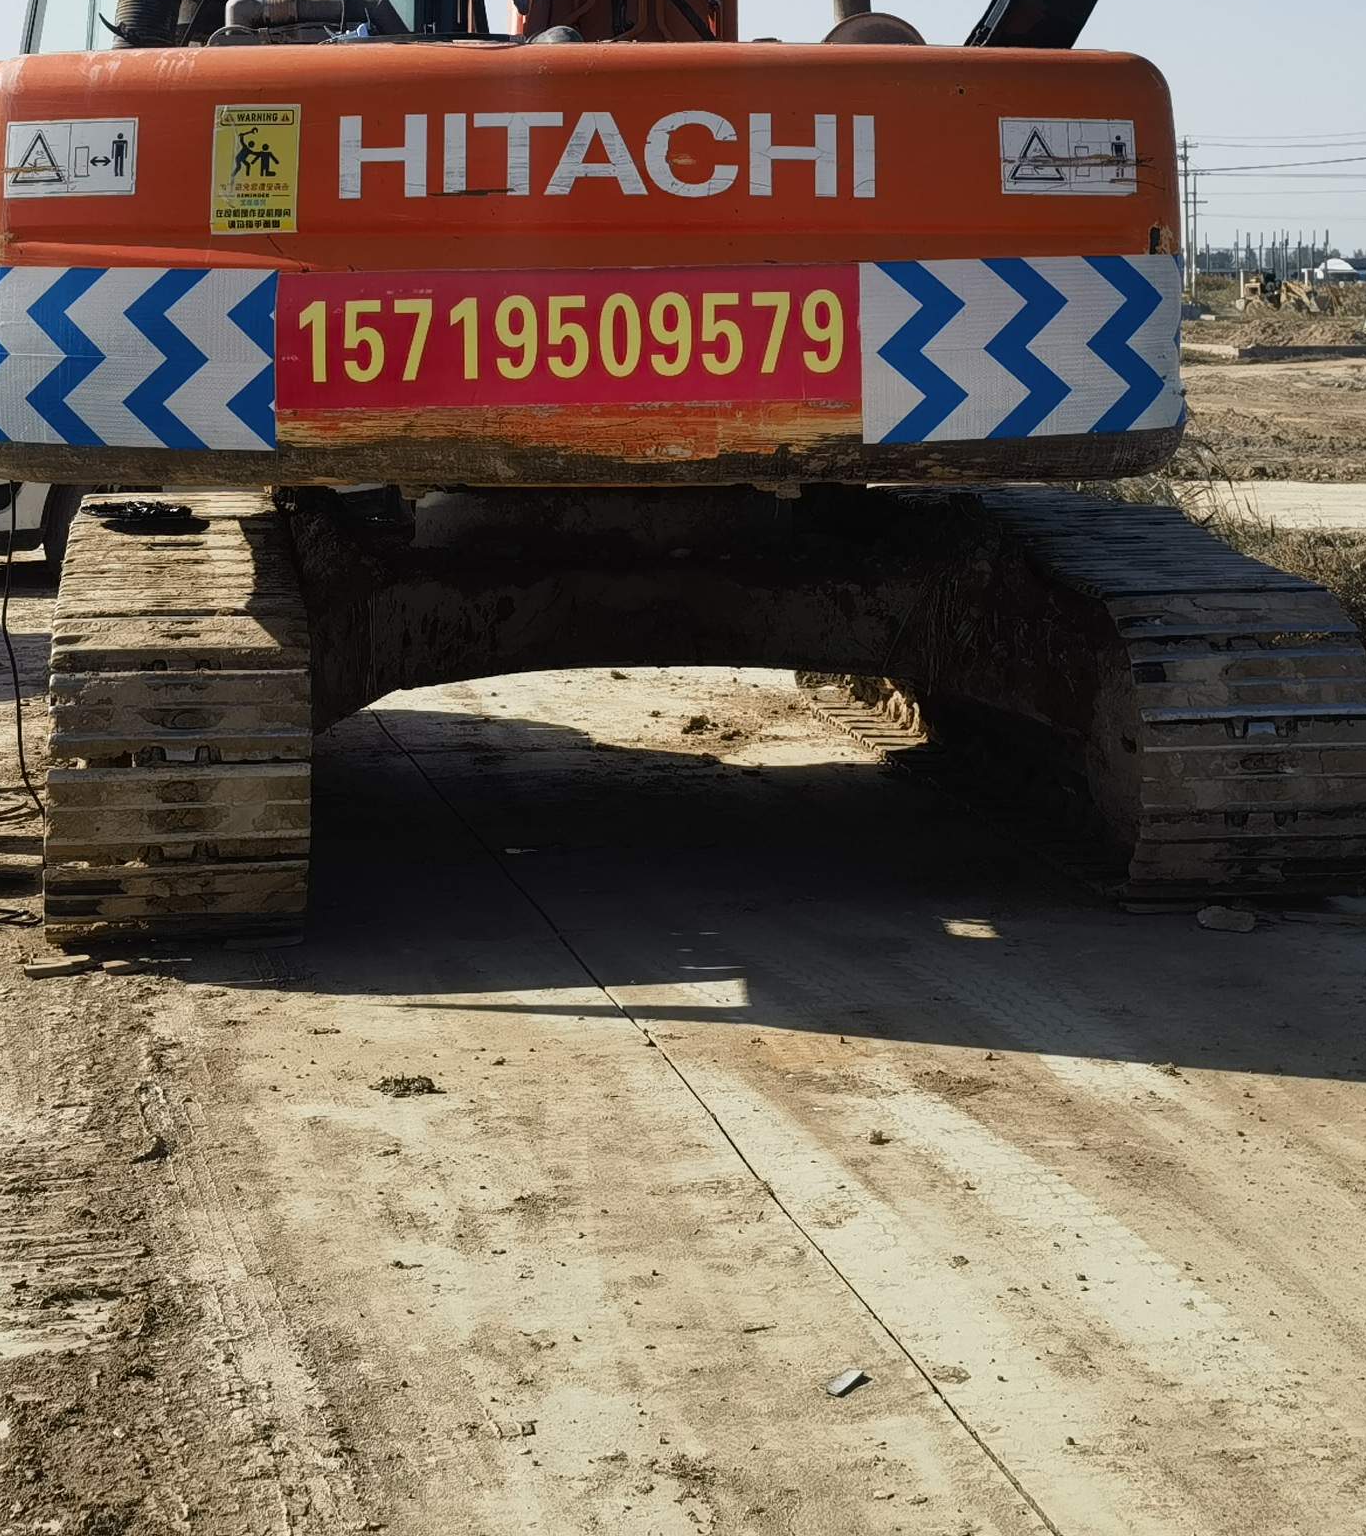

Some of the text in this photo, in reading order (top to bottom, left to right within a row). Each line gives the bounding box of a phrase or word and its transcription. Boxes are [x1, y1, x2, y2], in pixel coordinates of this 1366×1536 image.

[237, 112, 278, 122] WARNING
[339, 110, 875, 199] HITACHI
[299, 289, 844, 383] 15719509579
